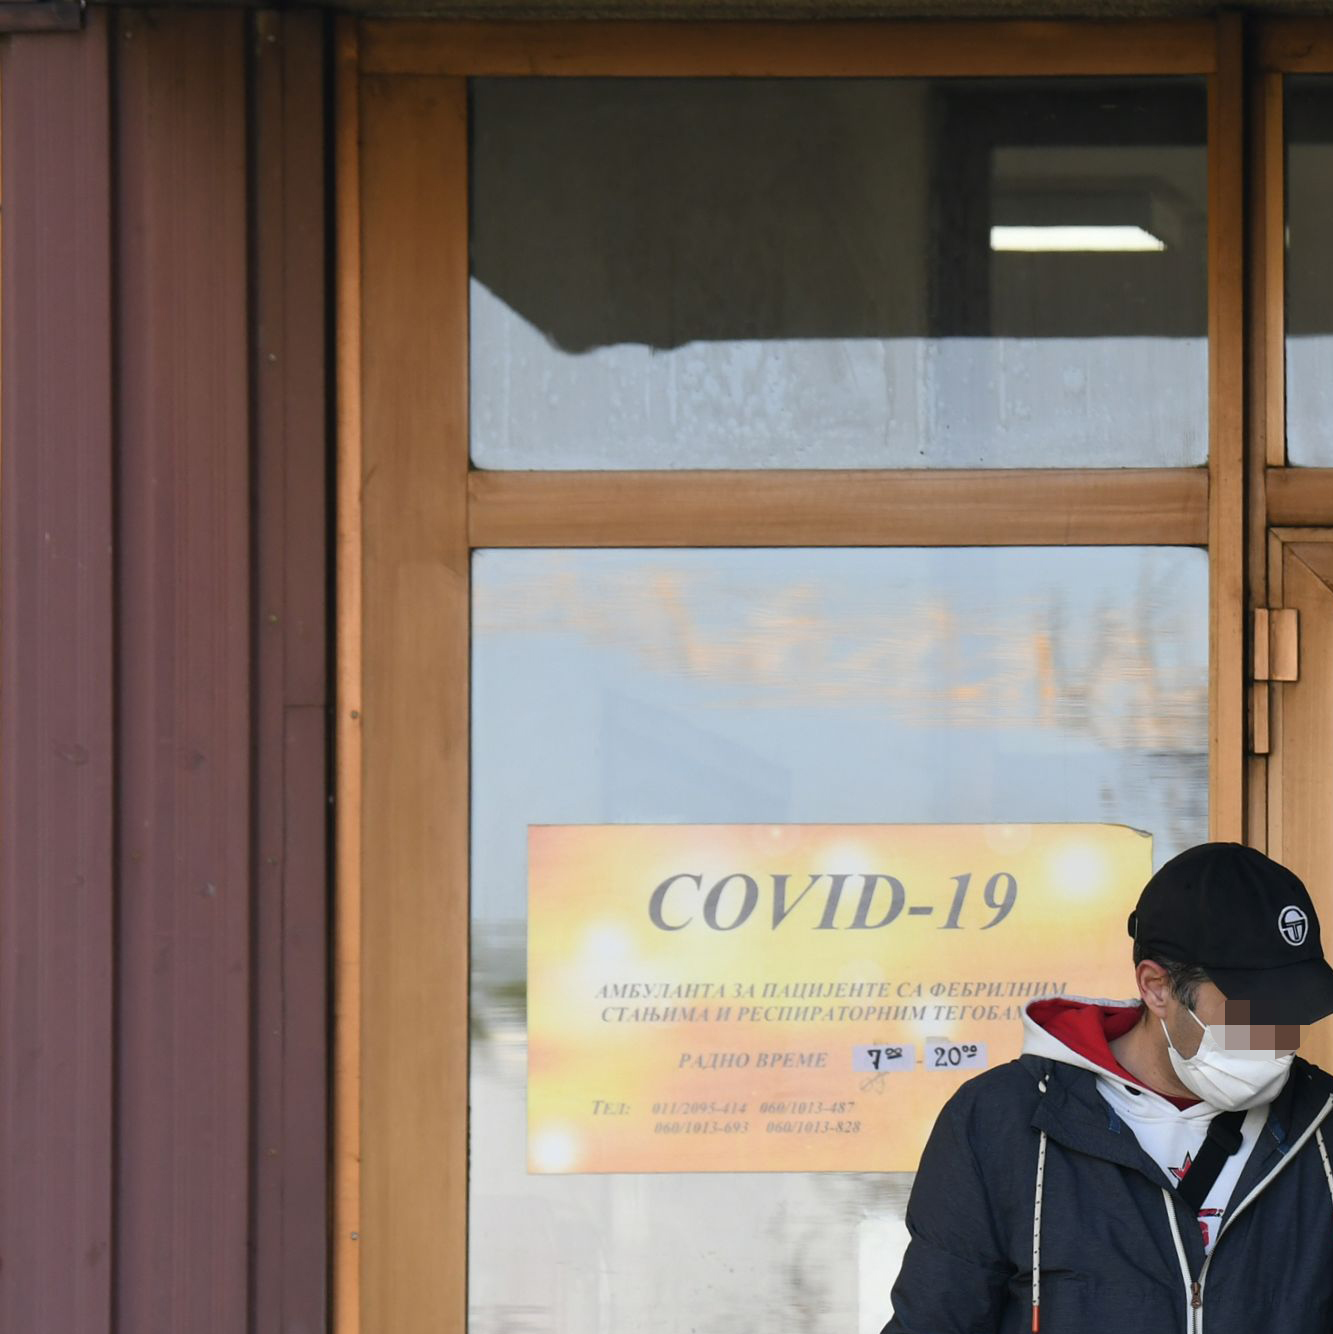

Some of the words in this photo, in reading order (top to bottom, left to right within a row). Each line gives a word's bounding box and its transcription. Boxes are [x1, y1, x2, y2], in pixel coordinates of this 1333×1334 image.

[647, 871, 1018, 932] COVID-19
[594, 982, 726, 999] АМБУЛАНТА
[732, 982, 756, 999] ЗА
[761, 982, 891, 1001] ПАЦИЈЕНТЕ
[896, 982, 923, 998] СА
[929, 981, 1068, 998] ФЕБРИЛНИМ
[601, 1005, 710, 1023] СТАЊИМА
[715, 1006, 732, 1022] И
[737, 1005, 926, 1022] РЕСПИРАТОРНИМ
[932, 1005, 1025, 1021] ТЕГОБАМ
[678, 1052, 750, 1071] РАДНО
[755, 1051, 828, 1069] ВРЕМЕ
